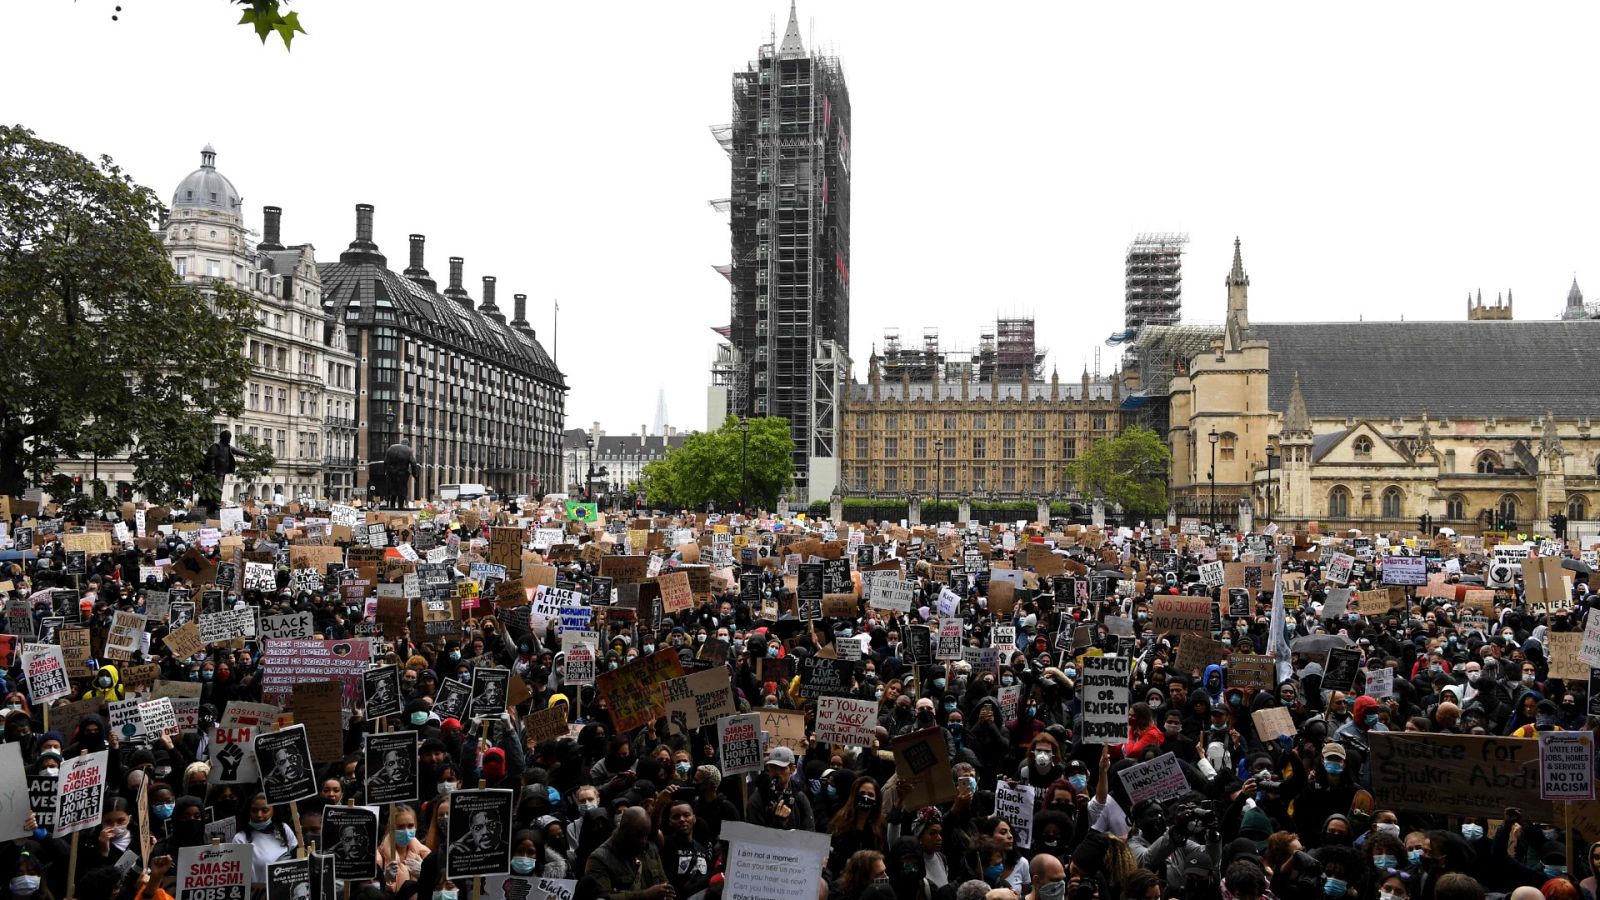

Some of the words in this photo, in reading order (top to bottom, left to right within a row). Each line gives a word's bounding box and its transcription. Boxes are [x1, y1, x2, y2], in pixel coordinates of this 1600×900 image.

[492, 543, 519, 557] FOR
[546, 588, 573, 599] BLACK
[882, 590, 893, 599] NOT
[544, 596, 572, 606] LIVES
[560, 606, 592, 616] DISMANTLE
[1157, 601, 1173, 612] NO
[1176, 601, 1210, 615] JUSTICE
[262, 616, 309, 632] BLACK
[562, 617, 590, 626] WHITE
[1155, 617, 1169, 629] NO
[273, 628, 305, 639] LIVES
[354, 624, 384, 633] RESPECT
[30, 657, 57, 669] SMASH
[805, 658, 833, 668] BLACK
[1083, 657, 1128, 672] RESPECT
[29, 663, 60, 677] RACISM!
[812, 669, 840, 677] LIVES
[33, 672, 49, 684] JOBS
[33, 677, 63, 691] HOMES
[809, 676, 841, 686] MATTER
[34, 686, 49, 697] FOR
[52, 683, 65, 694] ALL
[1097, 689, 1114, 701] OR
[110, 701, 138, 711] BLACK
[820, 699, 833, 708] IF
[836, 699, 857, 712] YOU
[859, 706, 875, 714] are
[1084, 701, 1127, 715] EXPECT
[115, 709, 139, 719] LIVES
[765, 713, 789, 727] AM
[819, 710, 832, 719] NOT
[836, 711, 868, 724] ANGRY
[148, 729, 162, 740] END
[164, 727, 179, 735] ONE
[724, 723, 754, 735] SMASH
[838, 725, 851, 733] NOT
[216, 727, 250, 744] BLM
[723, 732, 757, 744] RACISM!
[821, 733, 870, 745] ATTENTION
[724, 742, 748, 753] JOBS
[725, 748, 757, 759] HOMES
[1375, 736, 1466, 761] Justice
[1482, 738, 1522, 762] for
[724, 759, 742, 768] FOR
[743, 756, 759, 766] ALL
[1565, 754, 1588, 762] HOMES
[67, 765, 99, 783] SMASH
[1122, 771, 1139, 784] THE
[1139, 766, 1152, 776] UK
[1132, 767, 1174, 791] INNOCENT
[1549, 772, 1567, 781] NO
[1568, 772, 1585, 781] TO
[63, 774, 101, 794] RACISM!
[1546, 783, 1588, 792] RACISM
[63, 789, 89, 806] JOBS
[91, 785, 100, 796] &
[997, 788, 1024, 804] Black
[62, 797, 98, 816] HOMES
[997, 800, 1020, 814] Lives
[58, 811, 78, 827] FOR
[79, 806, 99, 821] ALL
[772, 854, 799, 863] moment
[191, 860, 241, 875] SMASH
[736, 860, 750, 868] Can
[752, 863, 763, 872] you
[185, 872, 244, 889] RACISM!
[735, 871, 750, 879] Can
[751, 874, 763, 882] you
[186, 888, 225, 900] JOBS
[229, 885, 242, 899] &
[749, 885, 762, 893] you
